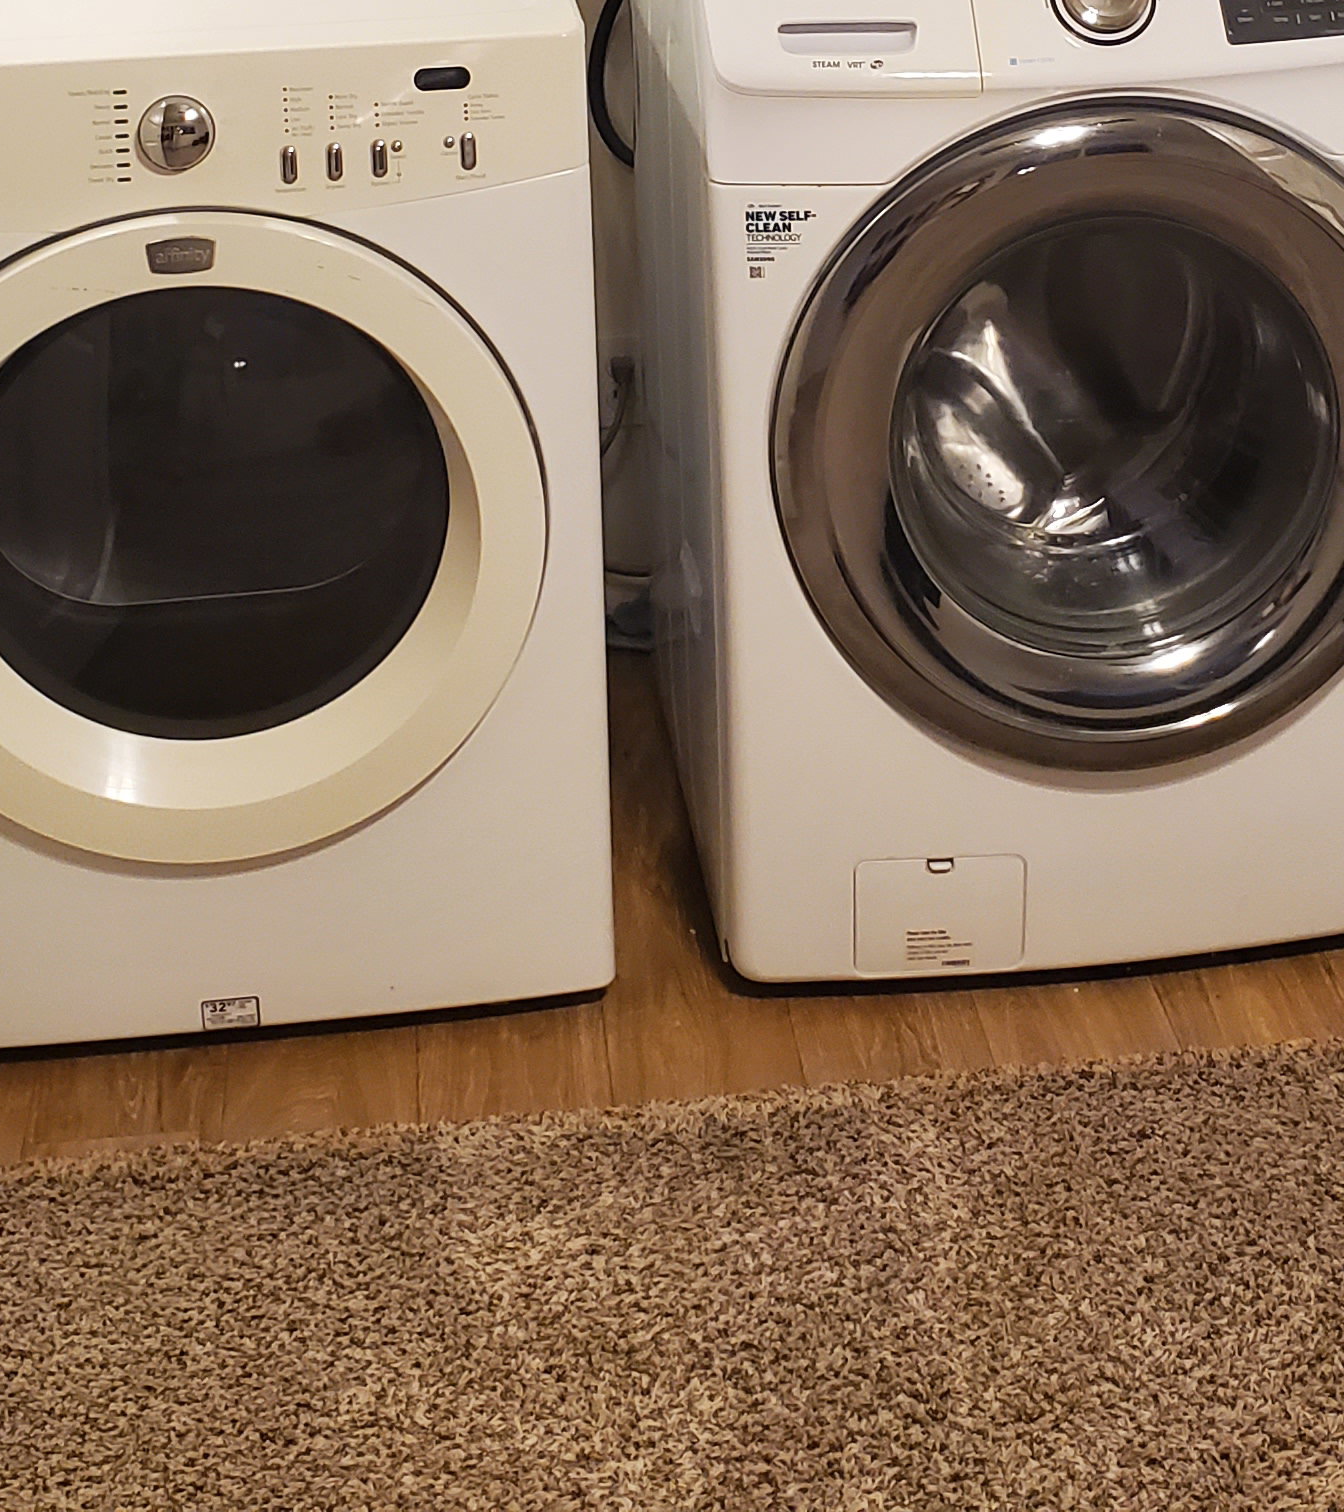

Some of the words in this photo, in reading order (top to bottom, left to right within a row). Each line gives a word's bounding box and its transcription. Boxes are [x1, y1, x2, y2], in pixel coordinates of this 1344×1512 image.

[812, 60, 841, 69] STEAM
[745, 210, 776, 222] NEW
[779, 210, 816, 221] SELF-
[745, 222, 792, 233] CLEAN
[746, 234, 802, 242] TECHNOLOGY
